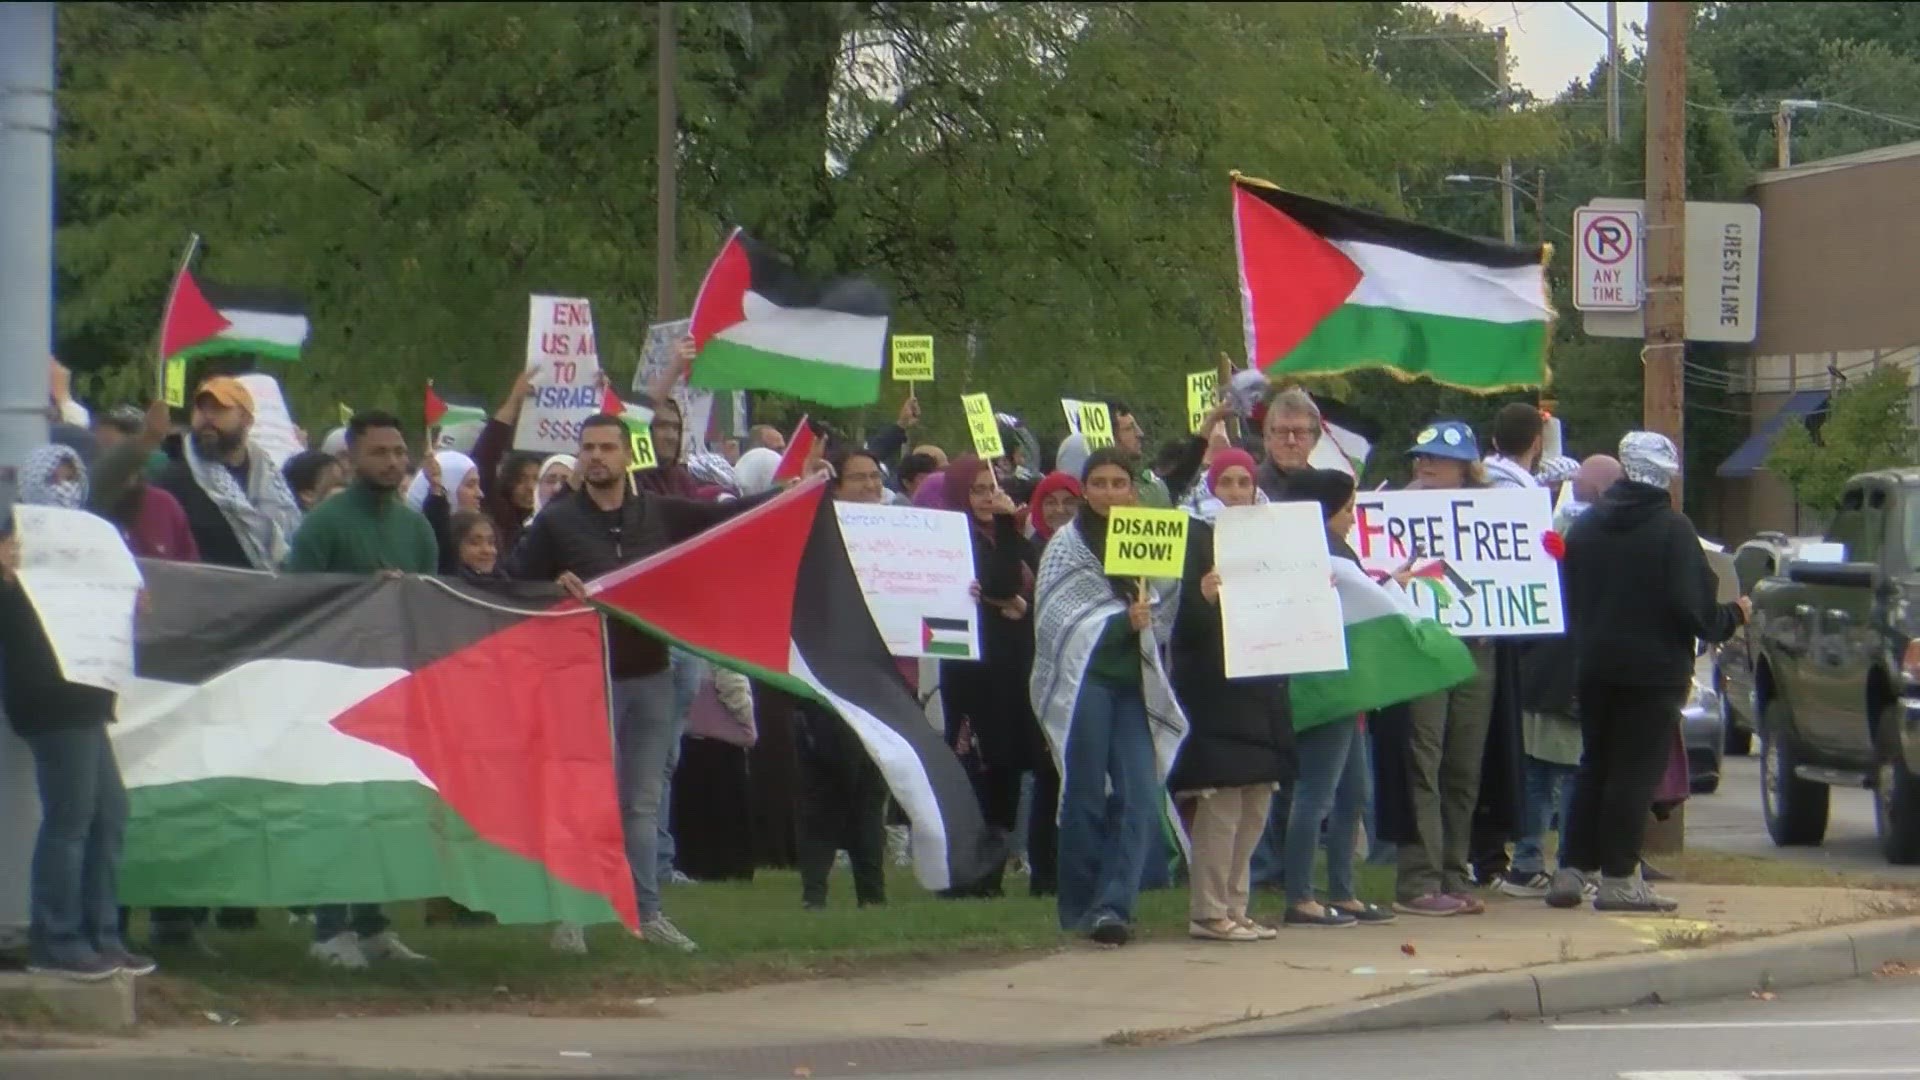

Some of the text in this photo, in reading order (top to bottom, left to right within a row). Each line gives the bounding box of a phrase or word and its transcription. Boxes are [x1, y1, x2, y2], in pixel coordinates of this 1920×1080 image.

[1594, 270, 1621, 283] ANY
[1720, 223, 1742, 326] CRESTLINE
[1592, 287, 1623, 301] TIME
[541, 333, 569, 355] US
[898, 352, 927, 364] NOW!
[553, 362, 576, 384] TO
[534, 385, 599, 409] ISRAEL
[1083, 405, 1105, 432] NO
[1112, 517, 1183, 538] DISARM
[1356, 500, 1531, 562] FREE FREE
[1118, 541, 1173, 562] NOW!
